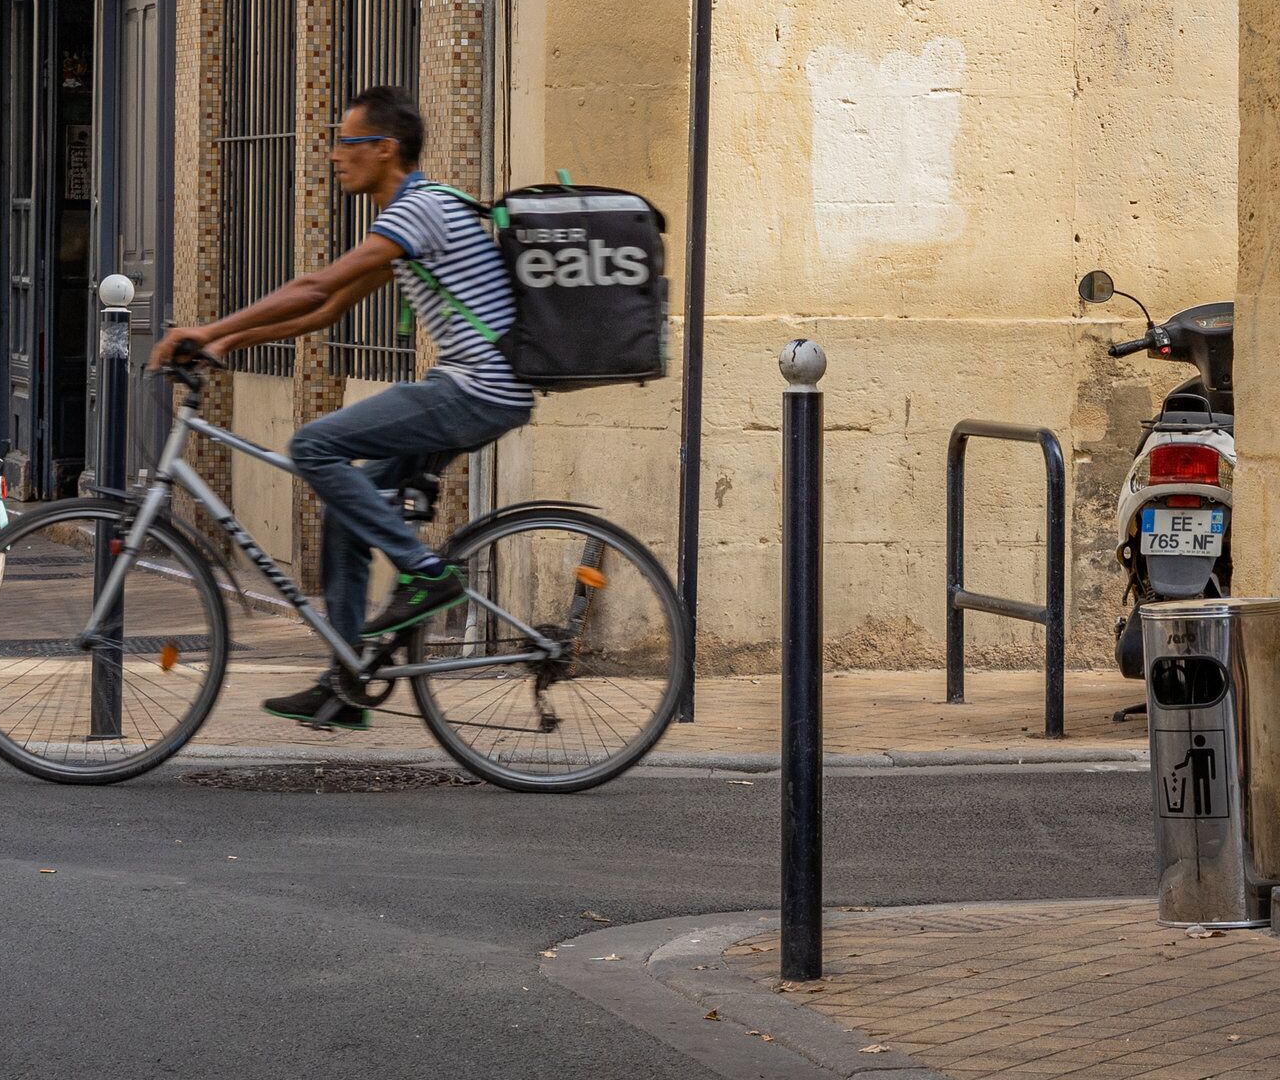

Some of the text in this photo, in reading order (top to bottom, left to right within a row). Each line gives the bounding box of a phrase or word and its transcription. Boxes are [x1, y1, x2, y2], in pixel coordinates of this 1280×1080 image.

[516, 228, 587, 243] UBER
[516, 239, 650, 288] eats
[1212, 524, 1223, 533] 33
[1148, 534, 1214, 550] 765 NF
